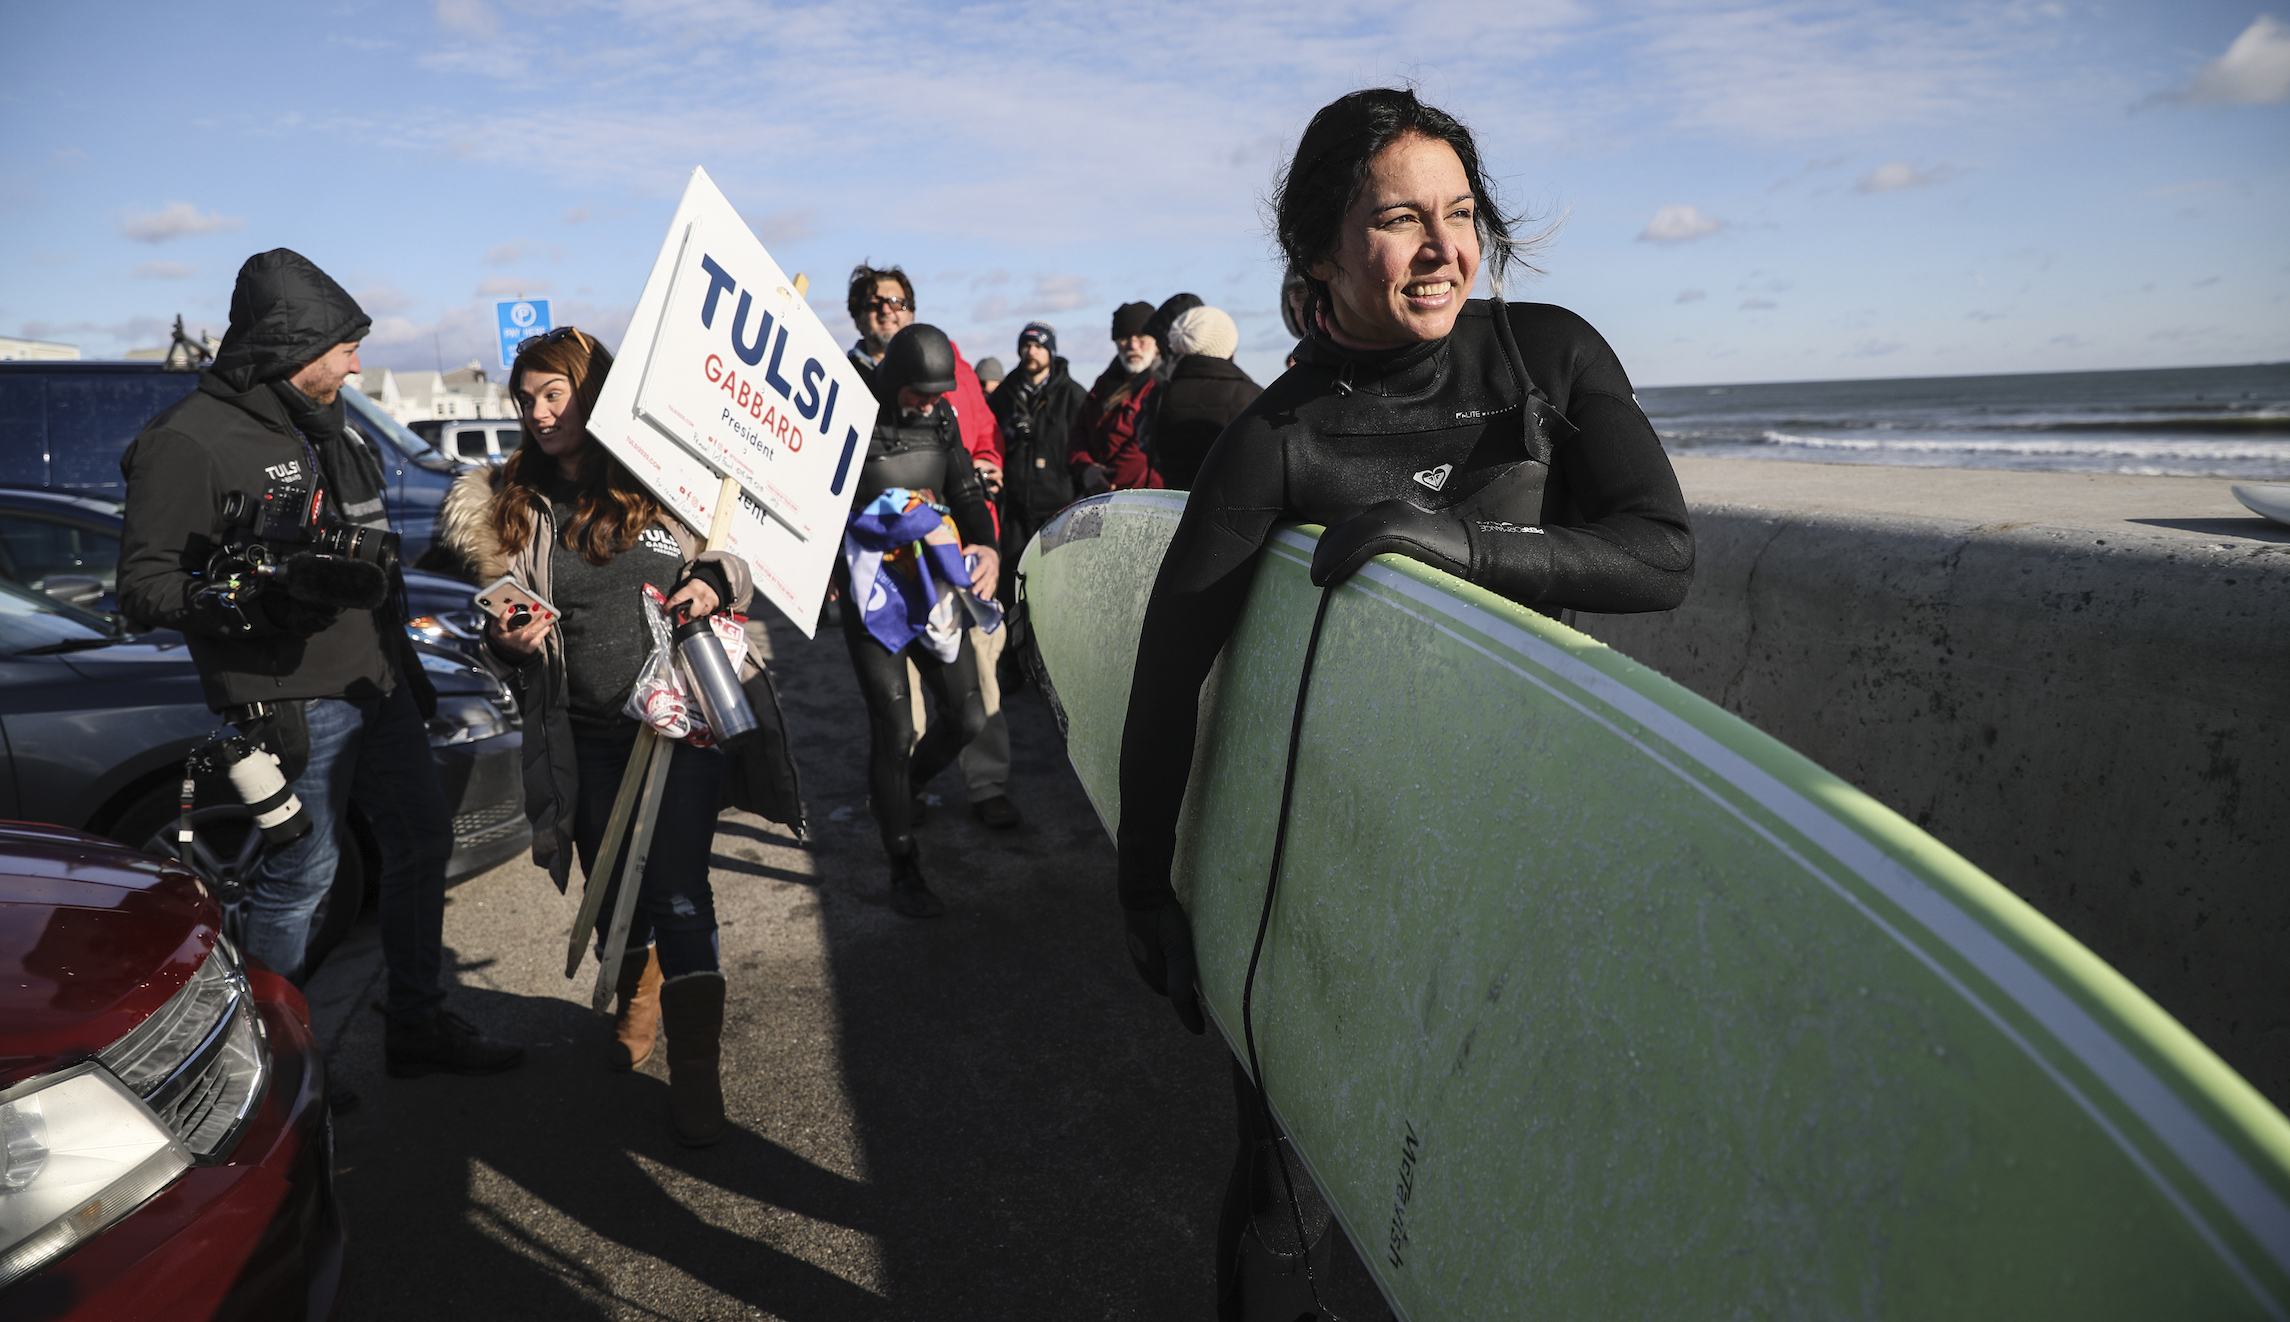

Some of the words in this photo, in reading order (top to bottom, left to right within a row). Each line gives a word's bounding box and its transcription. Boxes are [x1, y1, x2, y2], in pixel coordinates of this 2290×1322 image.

[701, 253, 839, 435] TULSI
[704, 353, 804, 454] GABBARD
[626, 435, 662, 472] TULSI2020.COM
[721, 407, 775, 462] President
[265, 460, 302, 480] TULSI
[645, 540, 682, 555] GABBARD
[1480, 523, 1545, 536] PERFORMANCE
[1388, 1119, 1420, 1270] McTavish
